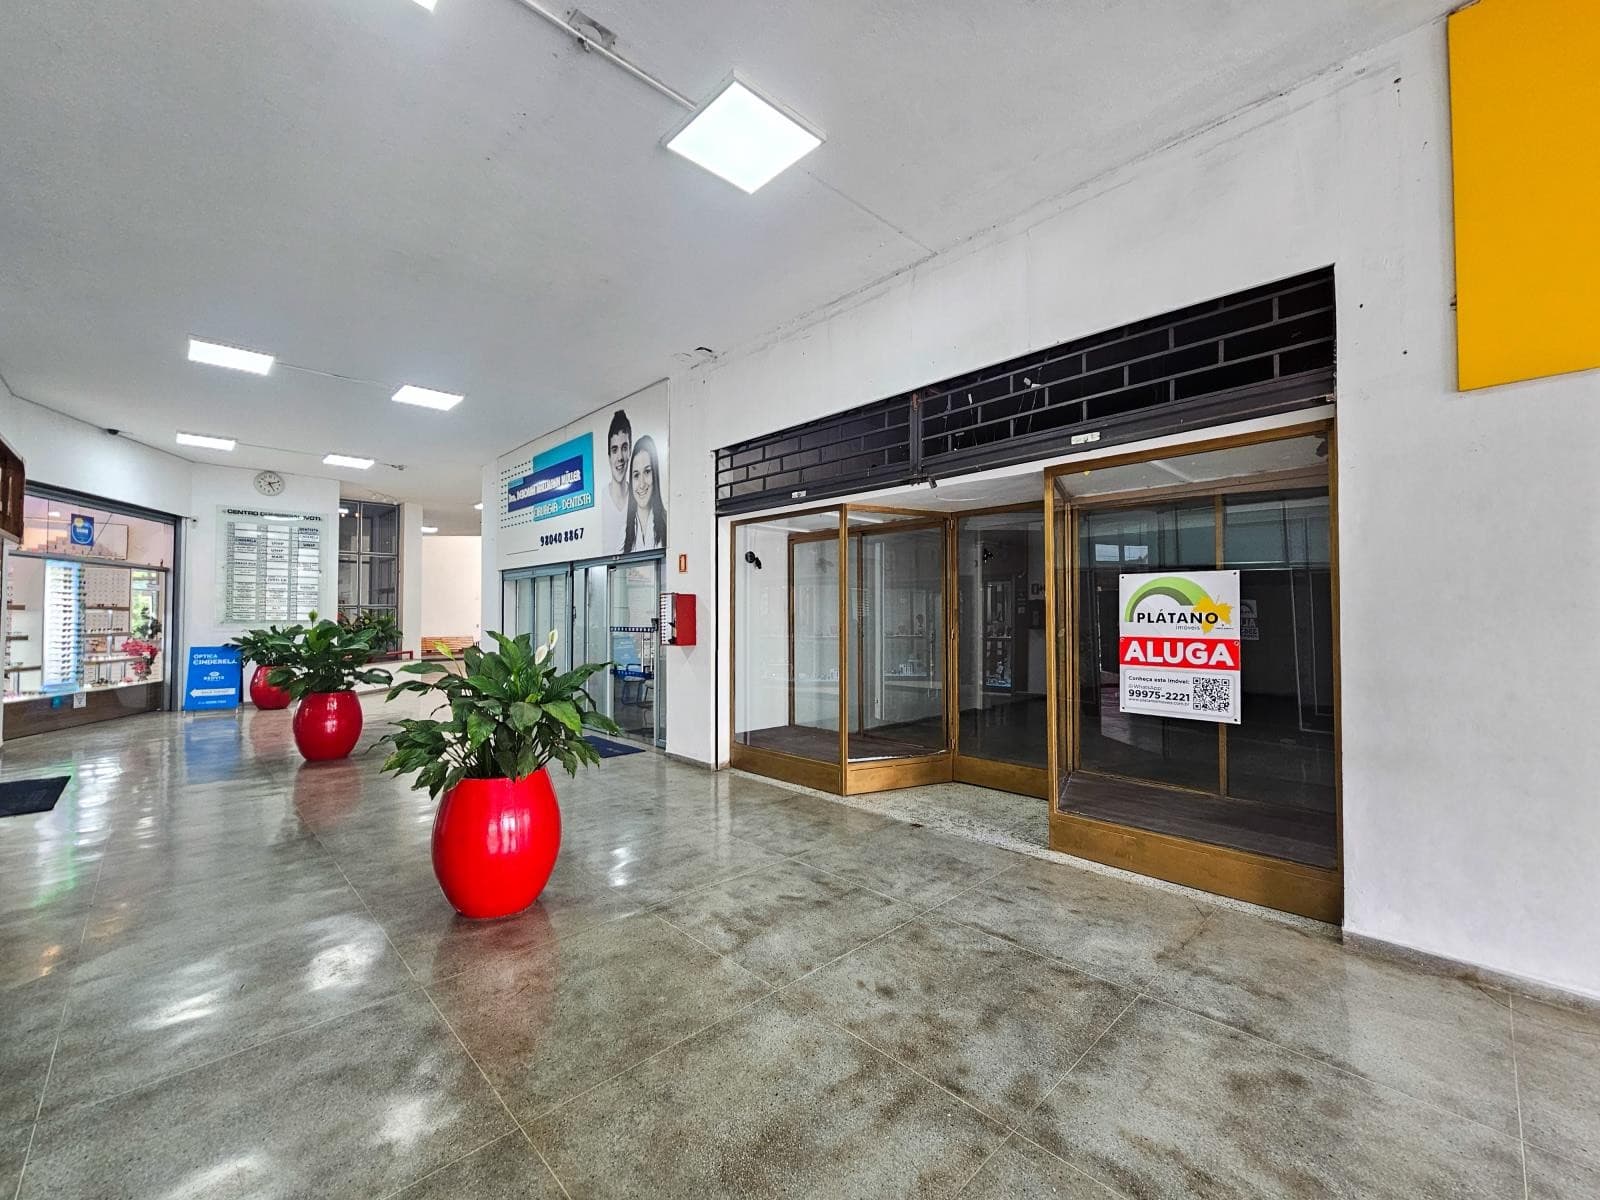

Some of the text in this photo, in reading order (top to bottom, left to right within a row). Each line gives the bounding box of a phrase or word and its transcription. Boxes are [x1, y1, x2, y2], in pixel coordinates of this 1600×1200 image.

[562, 492, 591, 510] DENTISTA
[227, 508, 259, 516] CENTRO
[540, 527, 584, 547] 98040 8867
[1137, 609, 1219, 624] PLÁTANO
[1124, 640, 1235, 667] ALUGA
[1128, 689, 1190, 702] 99975-2221
